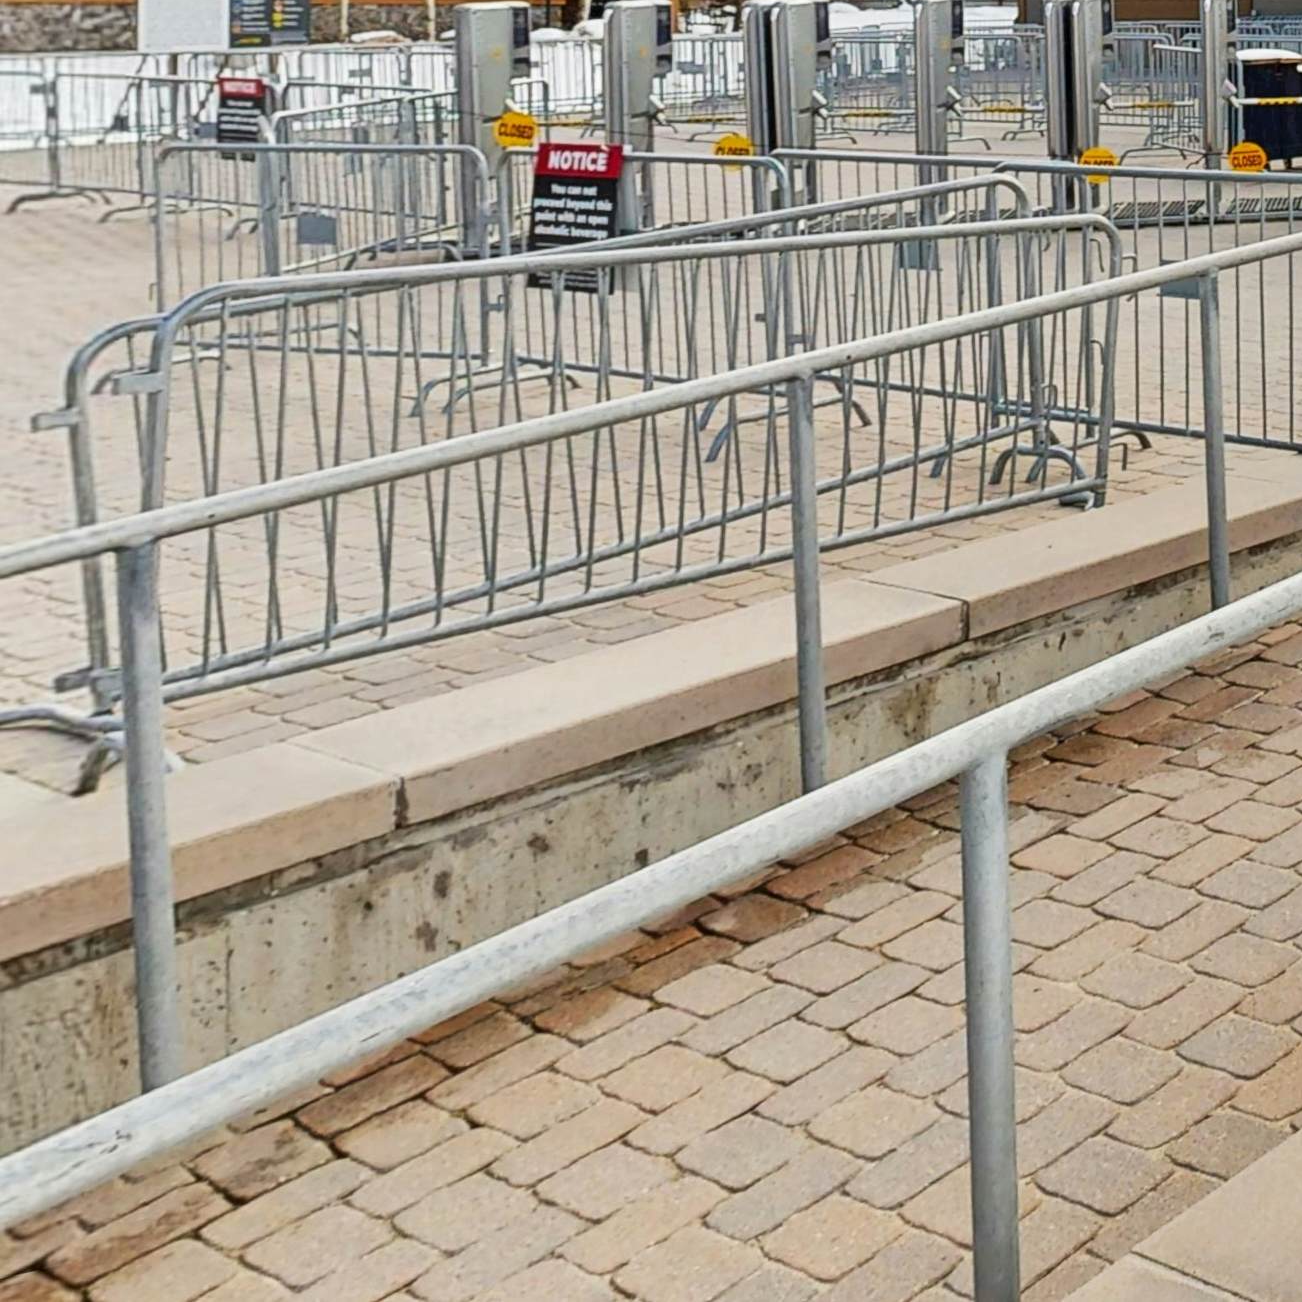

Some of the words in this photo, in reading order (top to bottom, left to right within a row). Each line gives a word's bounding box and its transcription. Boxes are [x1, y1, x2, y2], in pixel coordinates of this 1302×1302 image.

[498, 122, 533, 140] CLOSED
[548, 150, 609, 172] NOTICE
[1231, 154, 1263, 168] CLOSED
[551, 183, 566, 195] You
